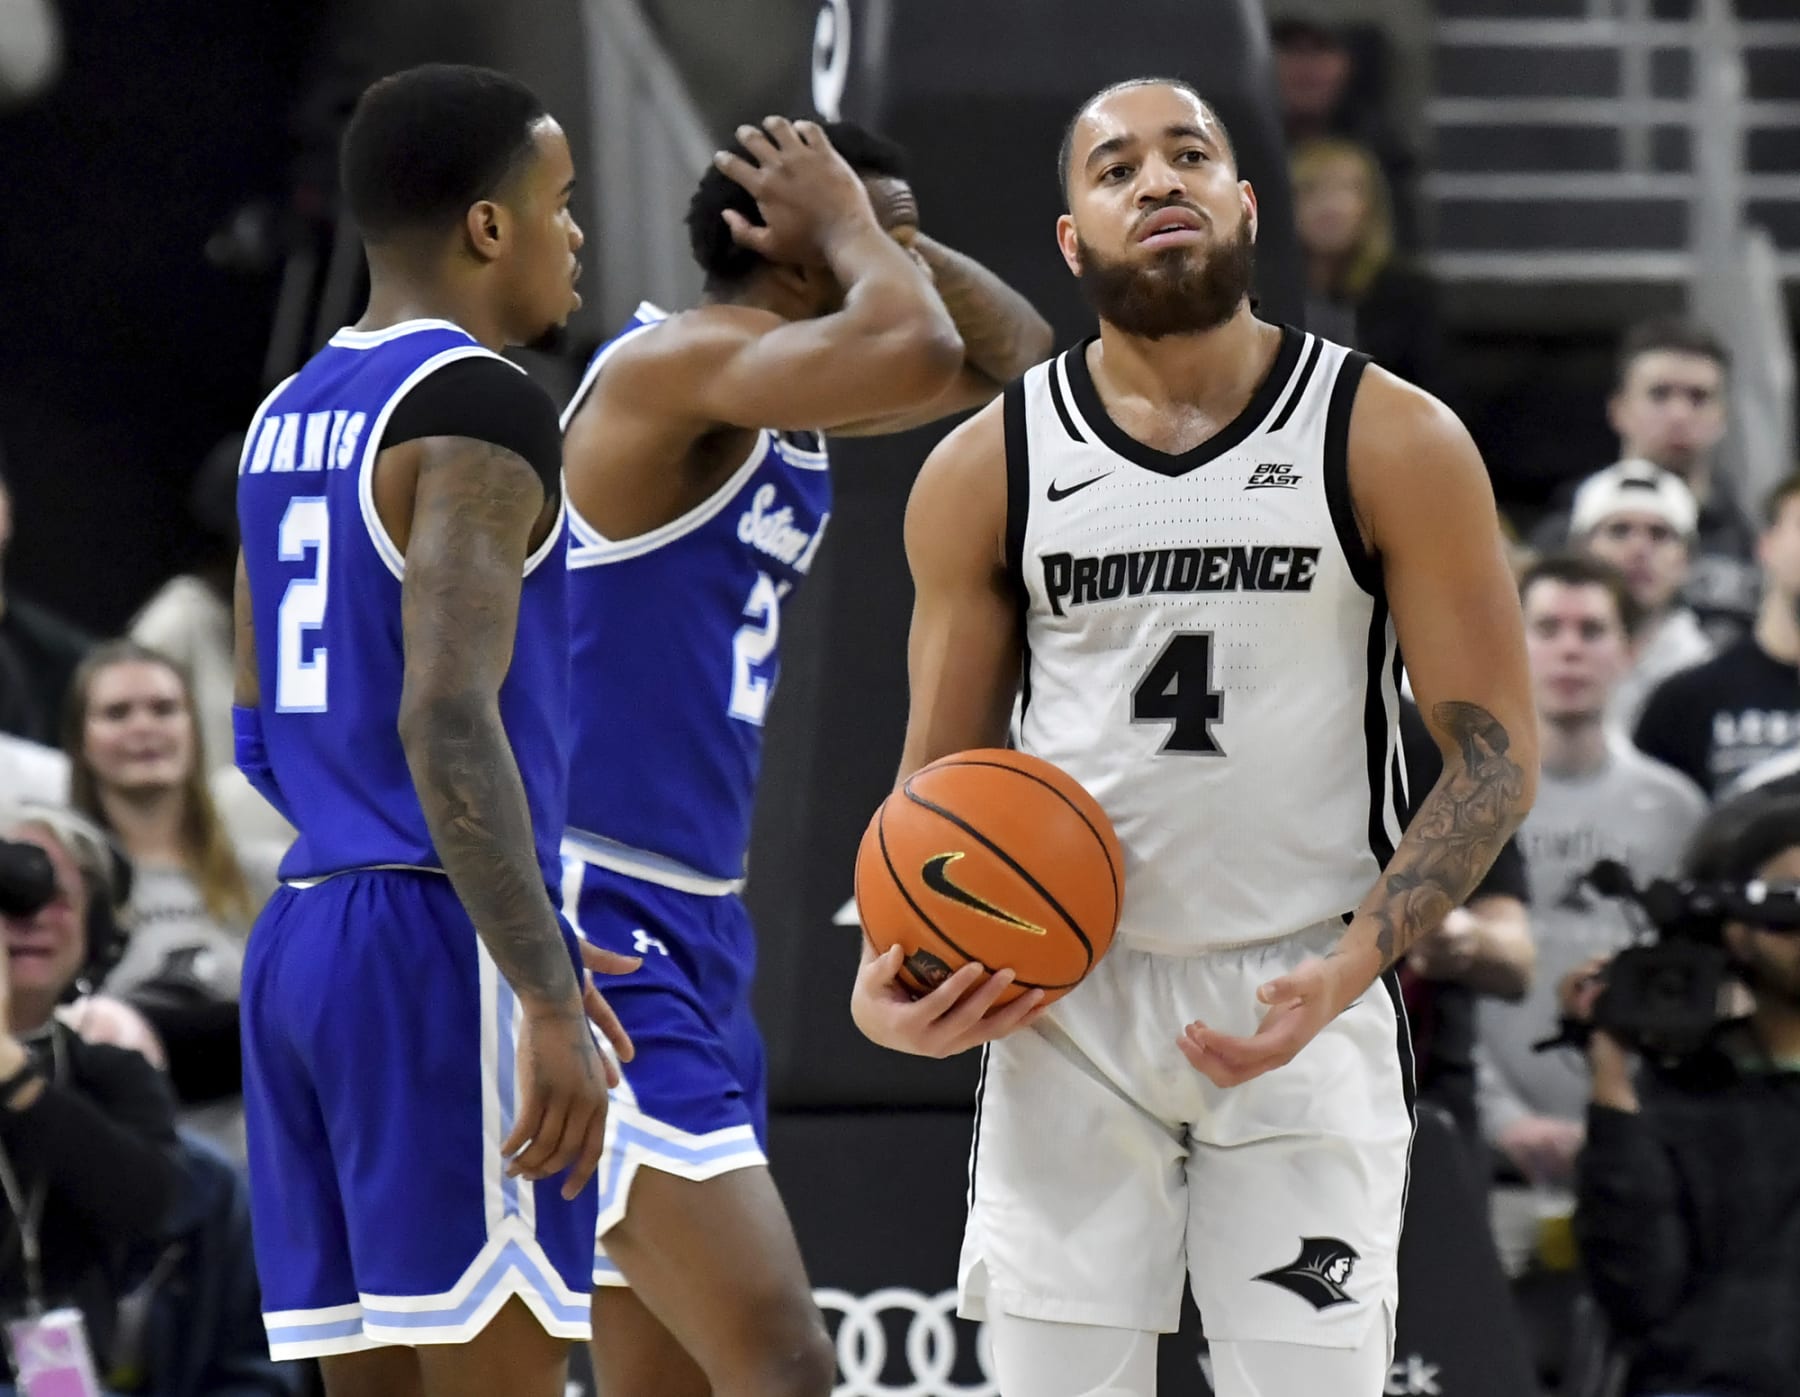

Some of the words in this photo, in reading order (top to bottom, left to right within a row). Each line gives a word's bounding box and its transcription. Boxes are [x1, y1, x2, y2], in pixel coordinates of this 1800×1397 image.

[1247, 474, 1303, 485] EAST
[1254, 463, 1294, 474] BIG
[275, 496, 330, 714] 2
[1040, 546, 1321, 618] PROVIDENCE
[728, 570, 792, 727] 2
[1129, 630, 1227, 757] 4
